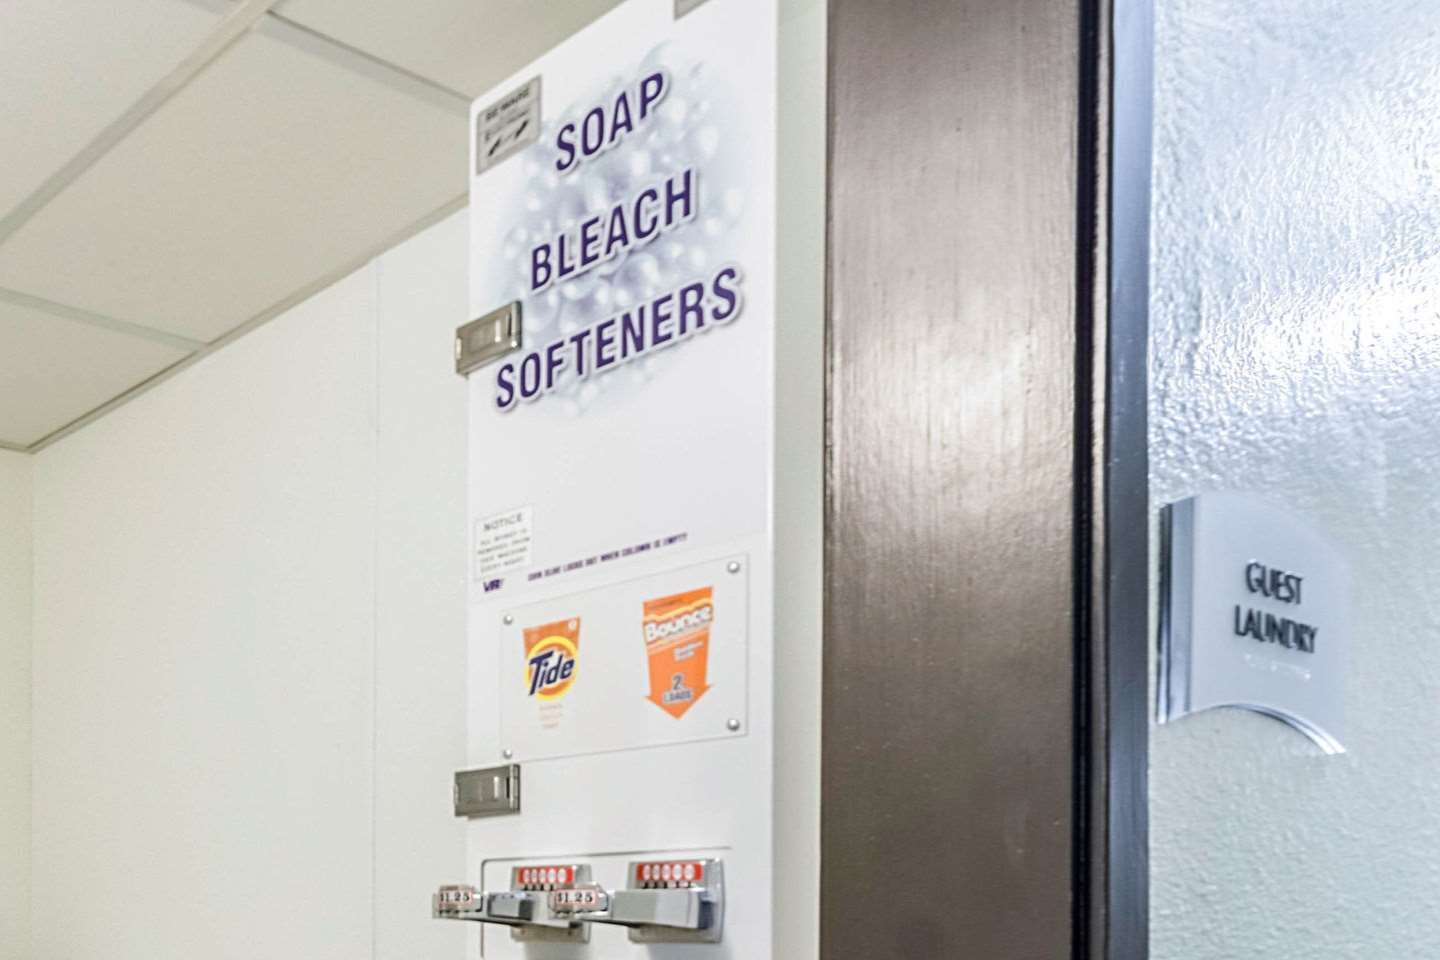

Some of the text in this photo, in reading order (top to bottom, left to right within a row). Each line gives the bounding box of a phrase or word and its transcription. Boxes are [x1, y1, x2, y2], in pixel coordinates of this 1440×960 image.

[555, 72, 664, 171] SOAP
[531, 168, 692, 291] BLEACH
[496, 267, 736, 408] SOFTENERS
[1246, 561, 1302, 604] GUEST
[1234, 604, 1318, 653] LAUNDRY
[528, 650, 575, 696] Tide
[671, 674, 683, 690] 2
